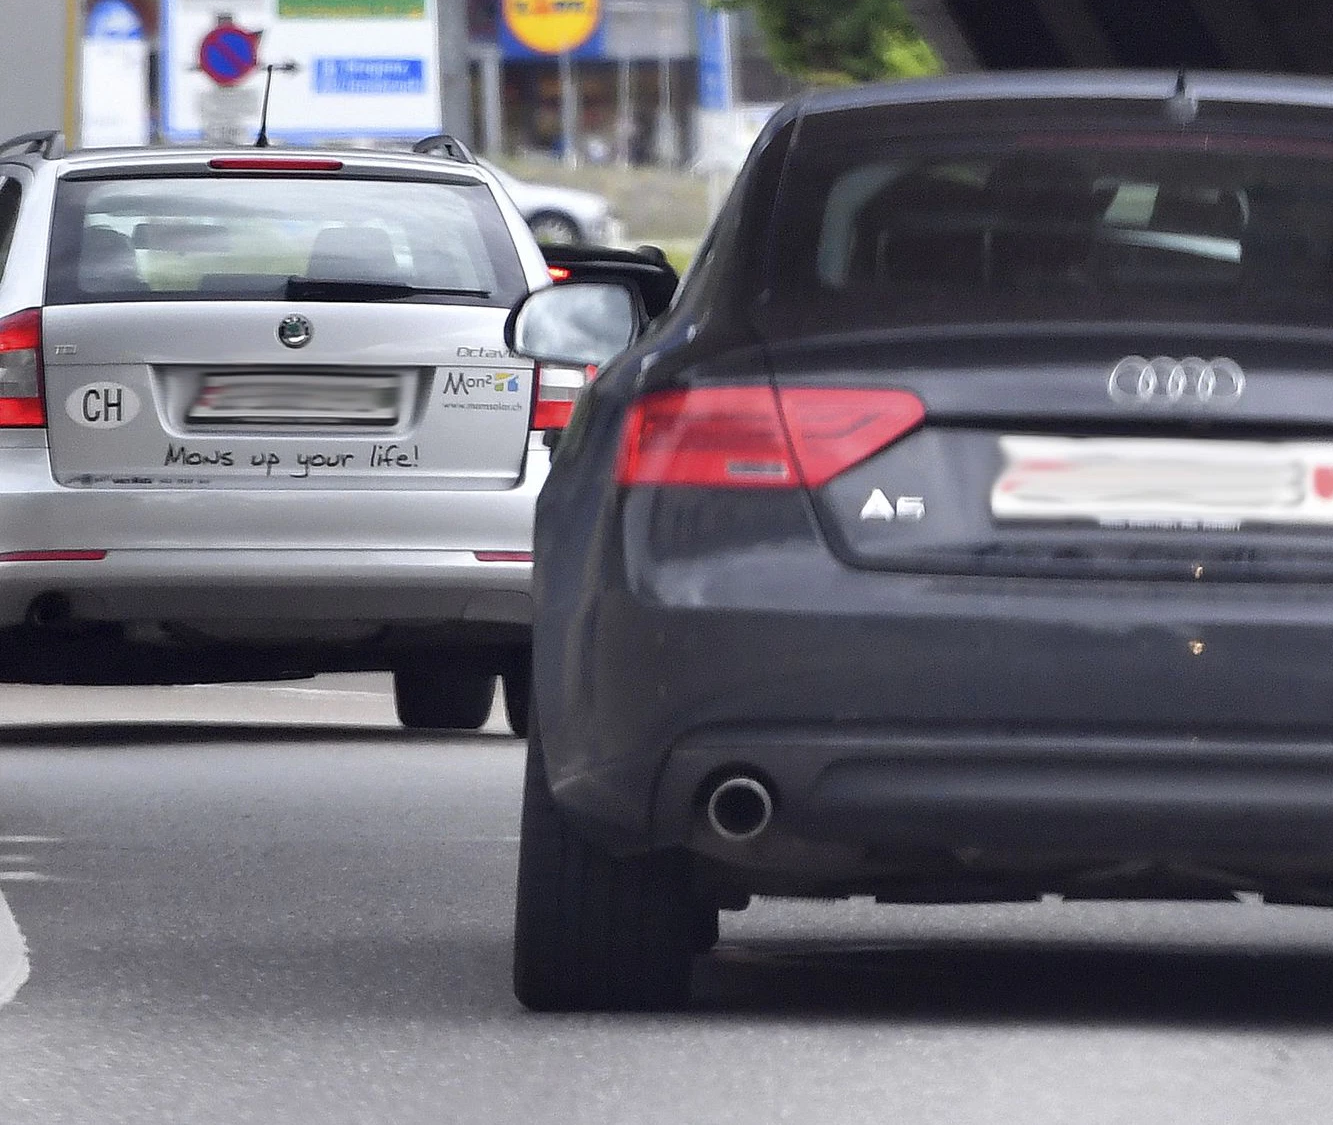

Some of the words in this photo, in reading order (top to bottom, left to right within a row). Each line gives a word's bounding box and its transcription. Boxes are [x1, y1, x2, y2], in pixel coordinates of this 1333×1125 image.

[82, 388, 123, 422] CH
[250, 450, 280, 475] up
[289, 451, 354, 478] your
[370, 444, 419, 468] life!
